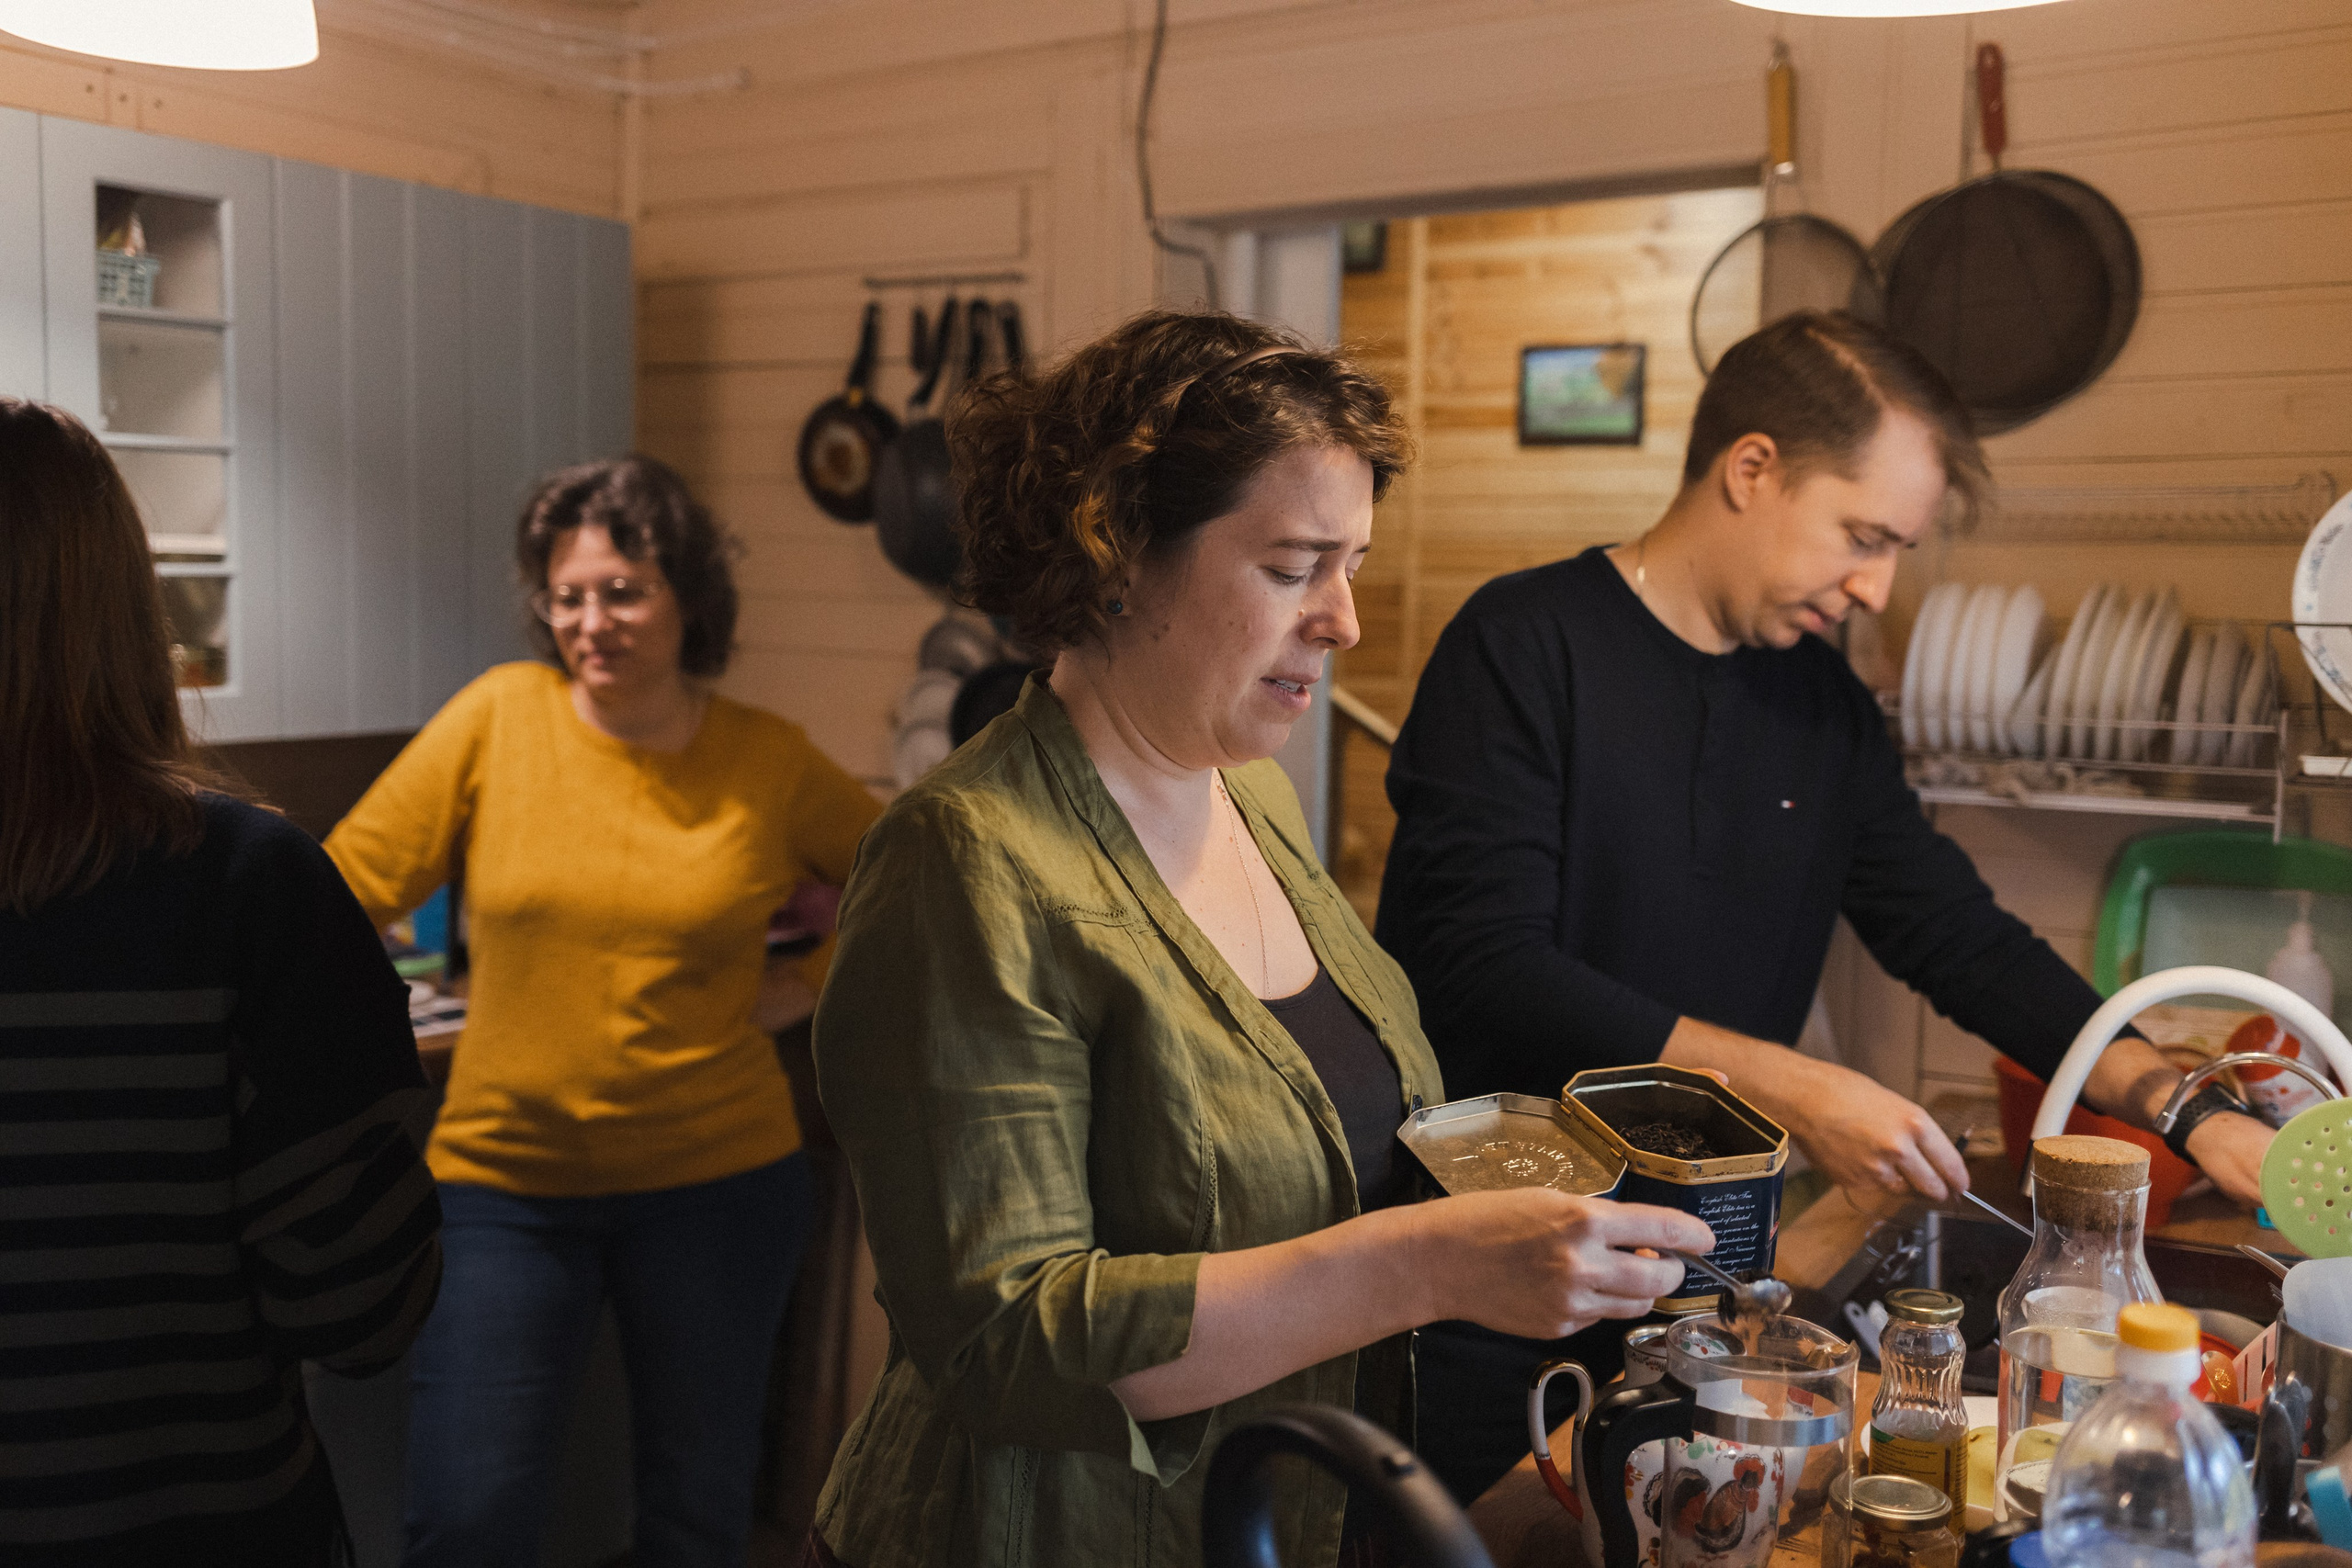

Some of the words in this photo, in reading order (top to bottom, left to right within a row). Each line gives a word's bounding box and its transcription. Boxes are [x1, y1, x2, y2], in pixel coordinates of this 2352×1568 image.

[1738, 1190, 1752, 1200] Tea
[1699, 1207, 1721, 1216] English
[1722, 1204, 1736, 1213] Elite
[1724, 1215, 1730, 1225] of
[1730, 1213, 1752, 1223] selected
[1723, 1227, 1742, 1235] grown
[1717, 1235, 1749, 1247] plantations
[1749, 1232, 1758, 1242] of
